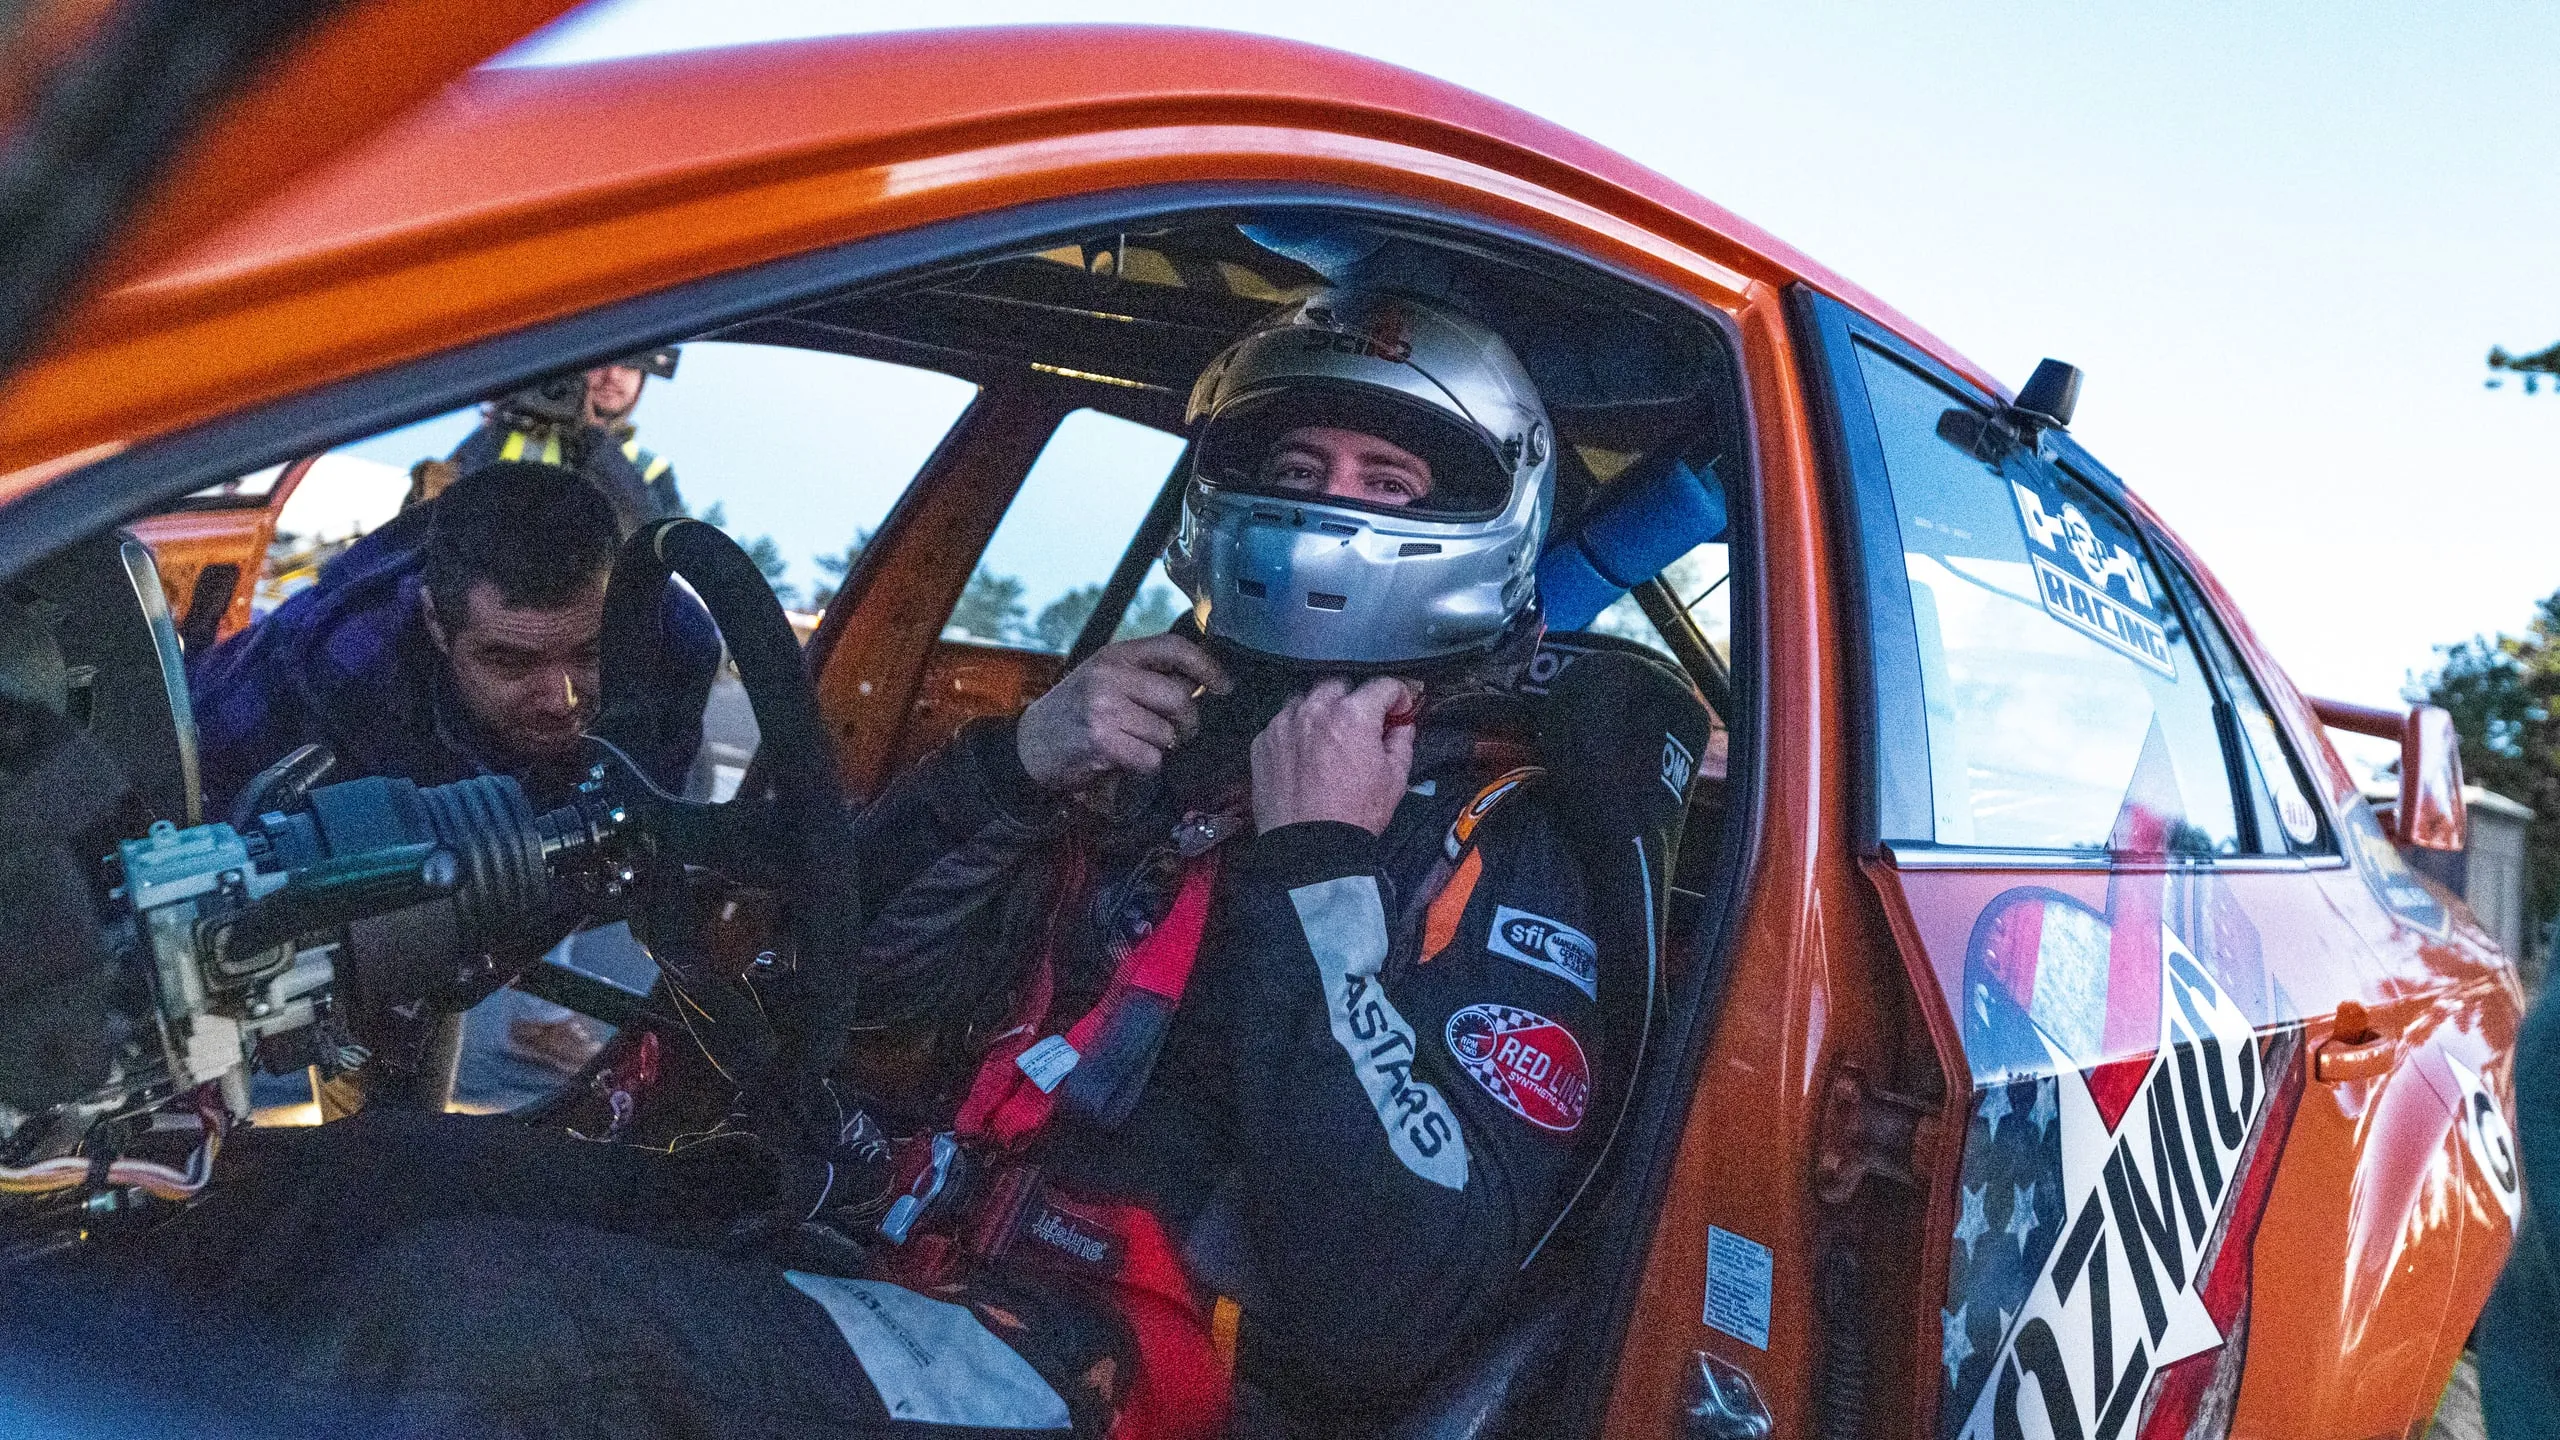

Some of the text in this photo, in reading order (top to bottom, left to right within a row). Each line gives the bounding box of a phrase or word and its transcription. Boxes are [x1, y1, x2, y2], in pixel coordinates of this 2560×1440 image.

[2041, 567, 2168, 665] RACING
[1662, 742, 1691, 793] OMP
[1510, 924, 1545, 950] sfi
[1344, 972, 1452, 1158] ASTARS
[1461, 1036, 1478, 1049] RPM
[1497, 1036, 1587, 1108] RED LINE
[1508, 1072, 1569, 1117] SYNTHETIC OIL
